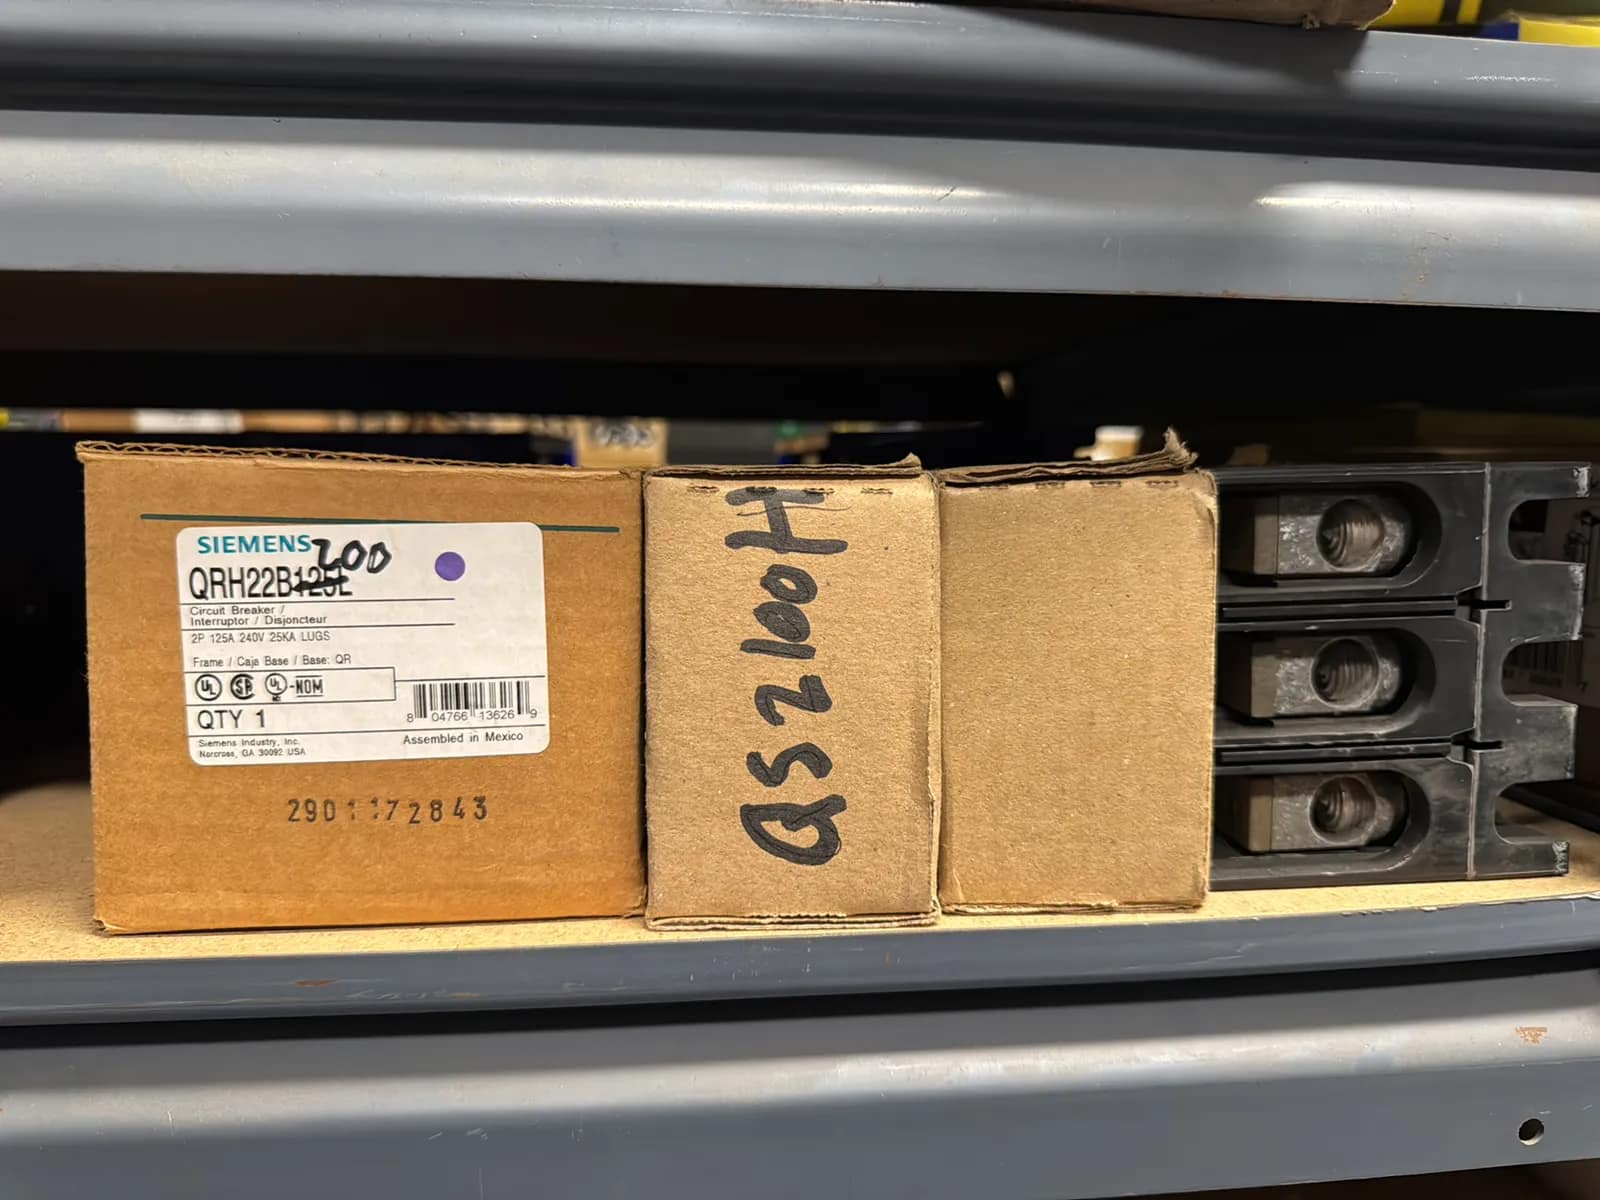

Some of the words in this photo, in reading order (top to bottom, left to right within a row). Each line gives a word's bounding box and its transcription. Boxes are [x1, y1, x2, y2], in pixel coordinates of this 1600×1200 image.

[197, 535, 311, 554] SIEMENS
[311, 538, 392, 574] 200
[190, 607, 225, 616] Circuit
[231, 605, 275, 615] Breaker
[190, 617, 249, 627] Interruptor
[264, 615, 328, 626] Disjoncteur
[191, 633, 205, 643] 2P
[211, 633, 235, 644] 125A
[239, 632, 265, 643] 240V
[269, 632, 297, 643] 25KA
[301, 630, 331, 642] LUGS
[193, 656, 224, 667] Frame
[237, 656, 260, 668] Caja
[264, 655, 289, 666] Base
[302, 655, 330, 666] Base:
[335, 654, 352, 665] QR
[197, 709, 243, 729] QTY
[255, 708, 266, 728] 1
[431, 711, 468, 722] 04766
[199, 738, 237, 748] Siemens
[403, 734, 464, 745] Assembled
[469, 734, 479, 743] in
[485, 732, 524, 743] Mexico
[241, 748, 255, 758] GA
[287, 747, 306, 756] USA
